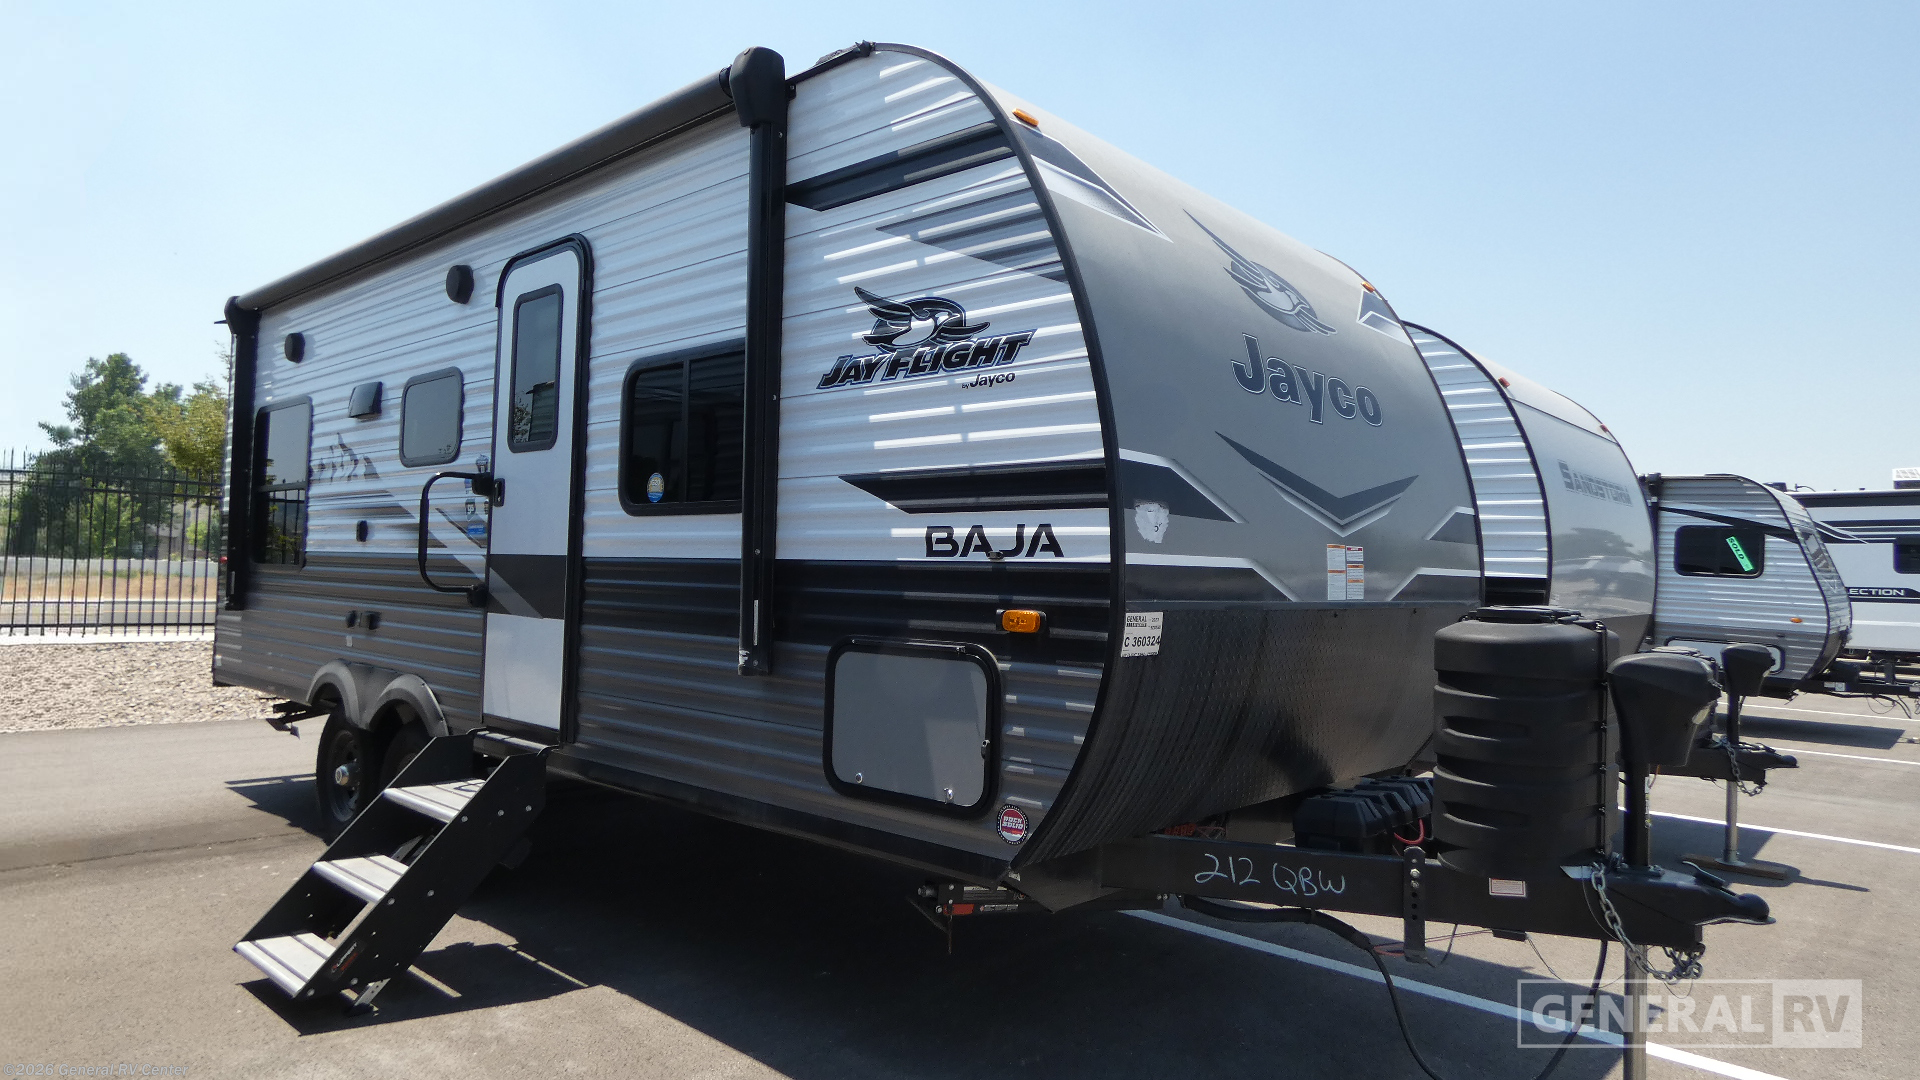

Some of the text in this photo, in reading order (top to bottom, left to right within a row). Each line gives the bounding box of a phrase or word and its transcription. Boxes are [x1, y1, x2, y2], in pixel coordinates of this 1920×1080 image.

[816, 329, 1037, 389] JAY FLIGHT
[970, 372, 1016, 388] Jayco
[1230, 332, 1383, 426] Jayco
[925, 524, 1064, 557] BAJA
[1728, 537, 1745, 560] SOLD
[1848, 588, 1905, 596] ECTION
[1124, 635, 1161, 647] C 360324
[1002, 821, 1024, 829] SOLID
[1003, 816, 1023, 824] ROCK
[1195, 853, 1346, 896] 212 QBW
